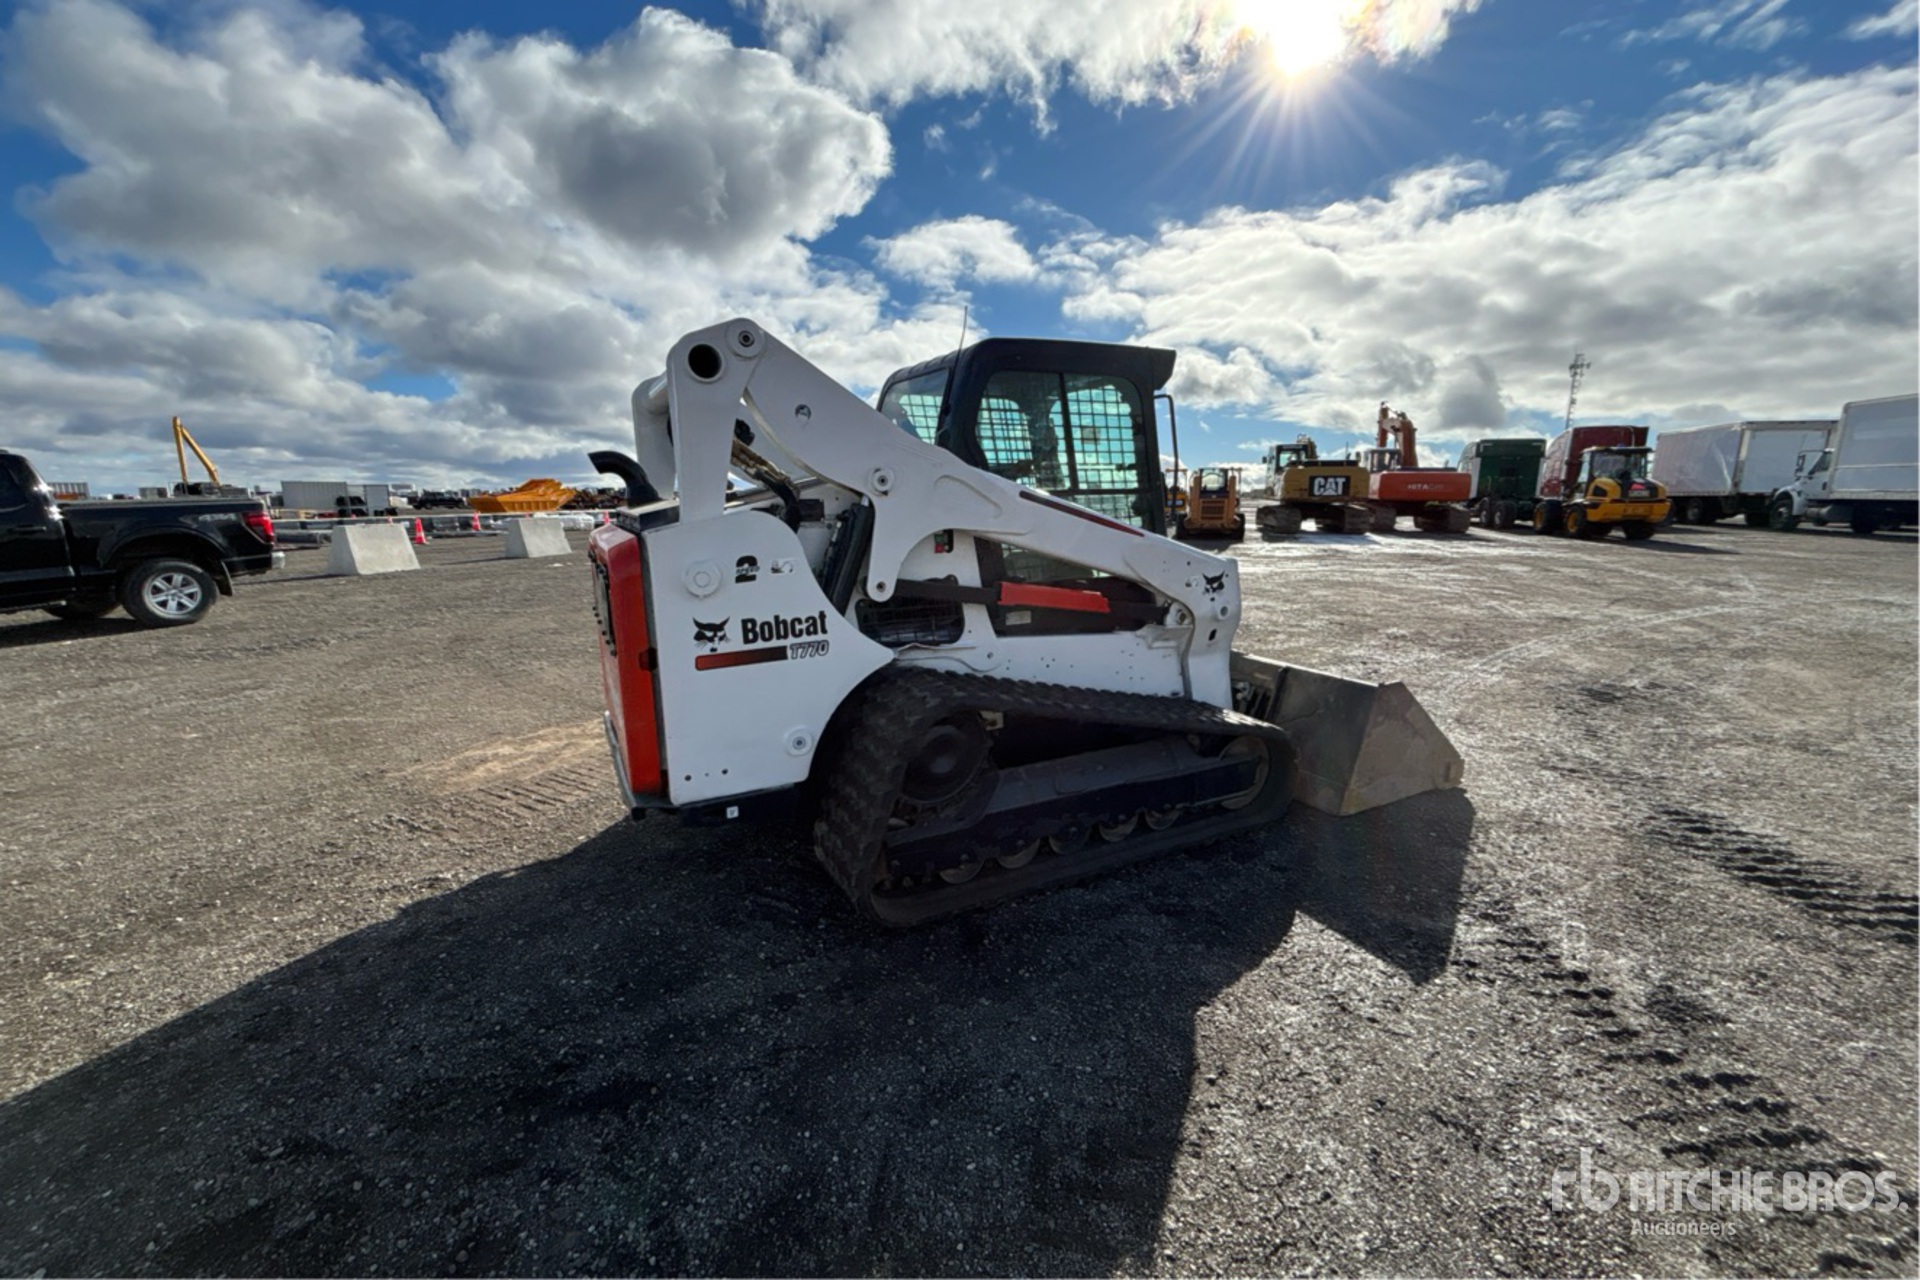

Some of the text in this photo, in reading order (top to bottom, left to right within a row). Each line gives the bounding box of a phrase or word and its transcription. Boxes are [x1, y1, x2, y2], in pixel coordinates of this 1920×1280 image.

[1313, 477, 1346, 496] CAT
[735, 555, 759, 584] 2
[741, 610, 829, 645] Bobcat
[789, 640, 830, 660] T770
